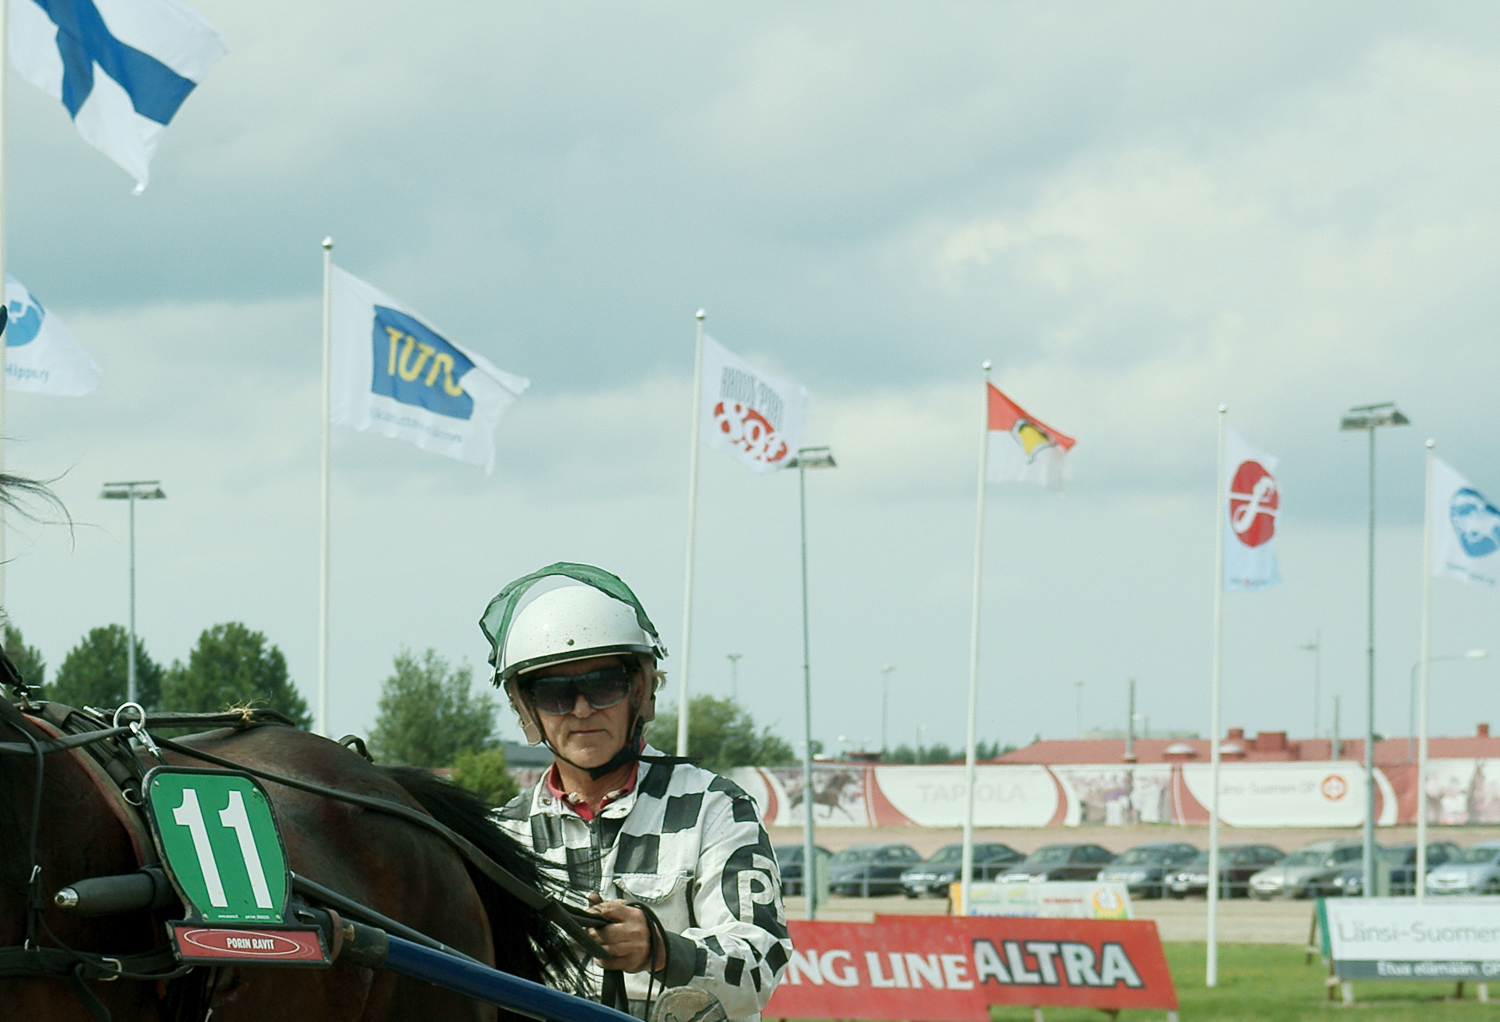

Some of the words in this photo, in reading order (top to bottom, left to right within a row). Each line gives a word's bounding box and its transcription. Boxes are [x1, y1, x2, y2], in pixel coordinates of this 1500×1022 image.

[918, 783, 1029, 804] TAPOLA
[172, 788, 274, 909] 11
[226, 937, 251, 949] PORIN
[252, 938, 275, 950] RAVIT
[864, 952, 974, 990] LINE
[972, 938, 1146, 989] ALTRA
